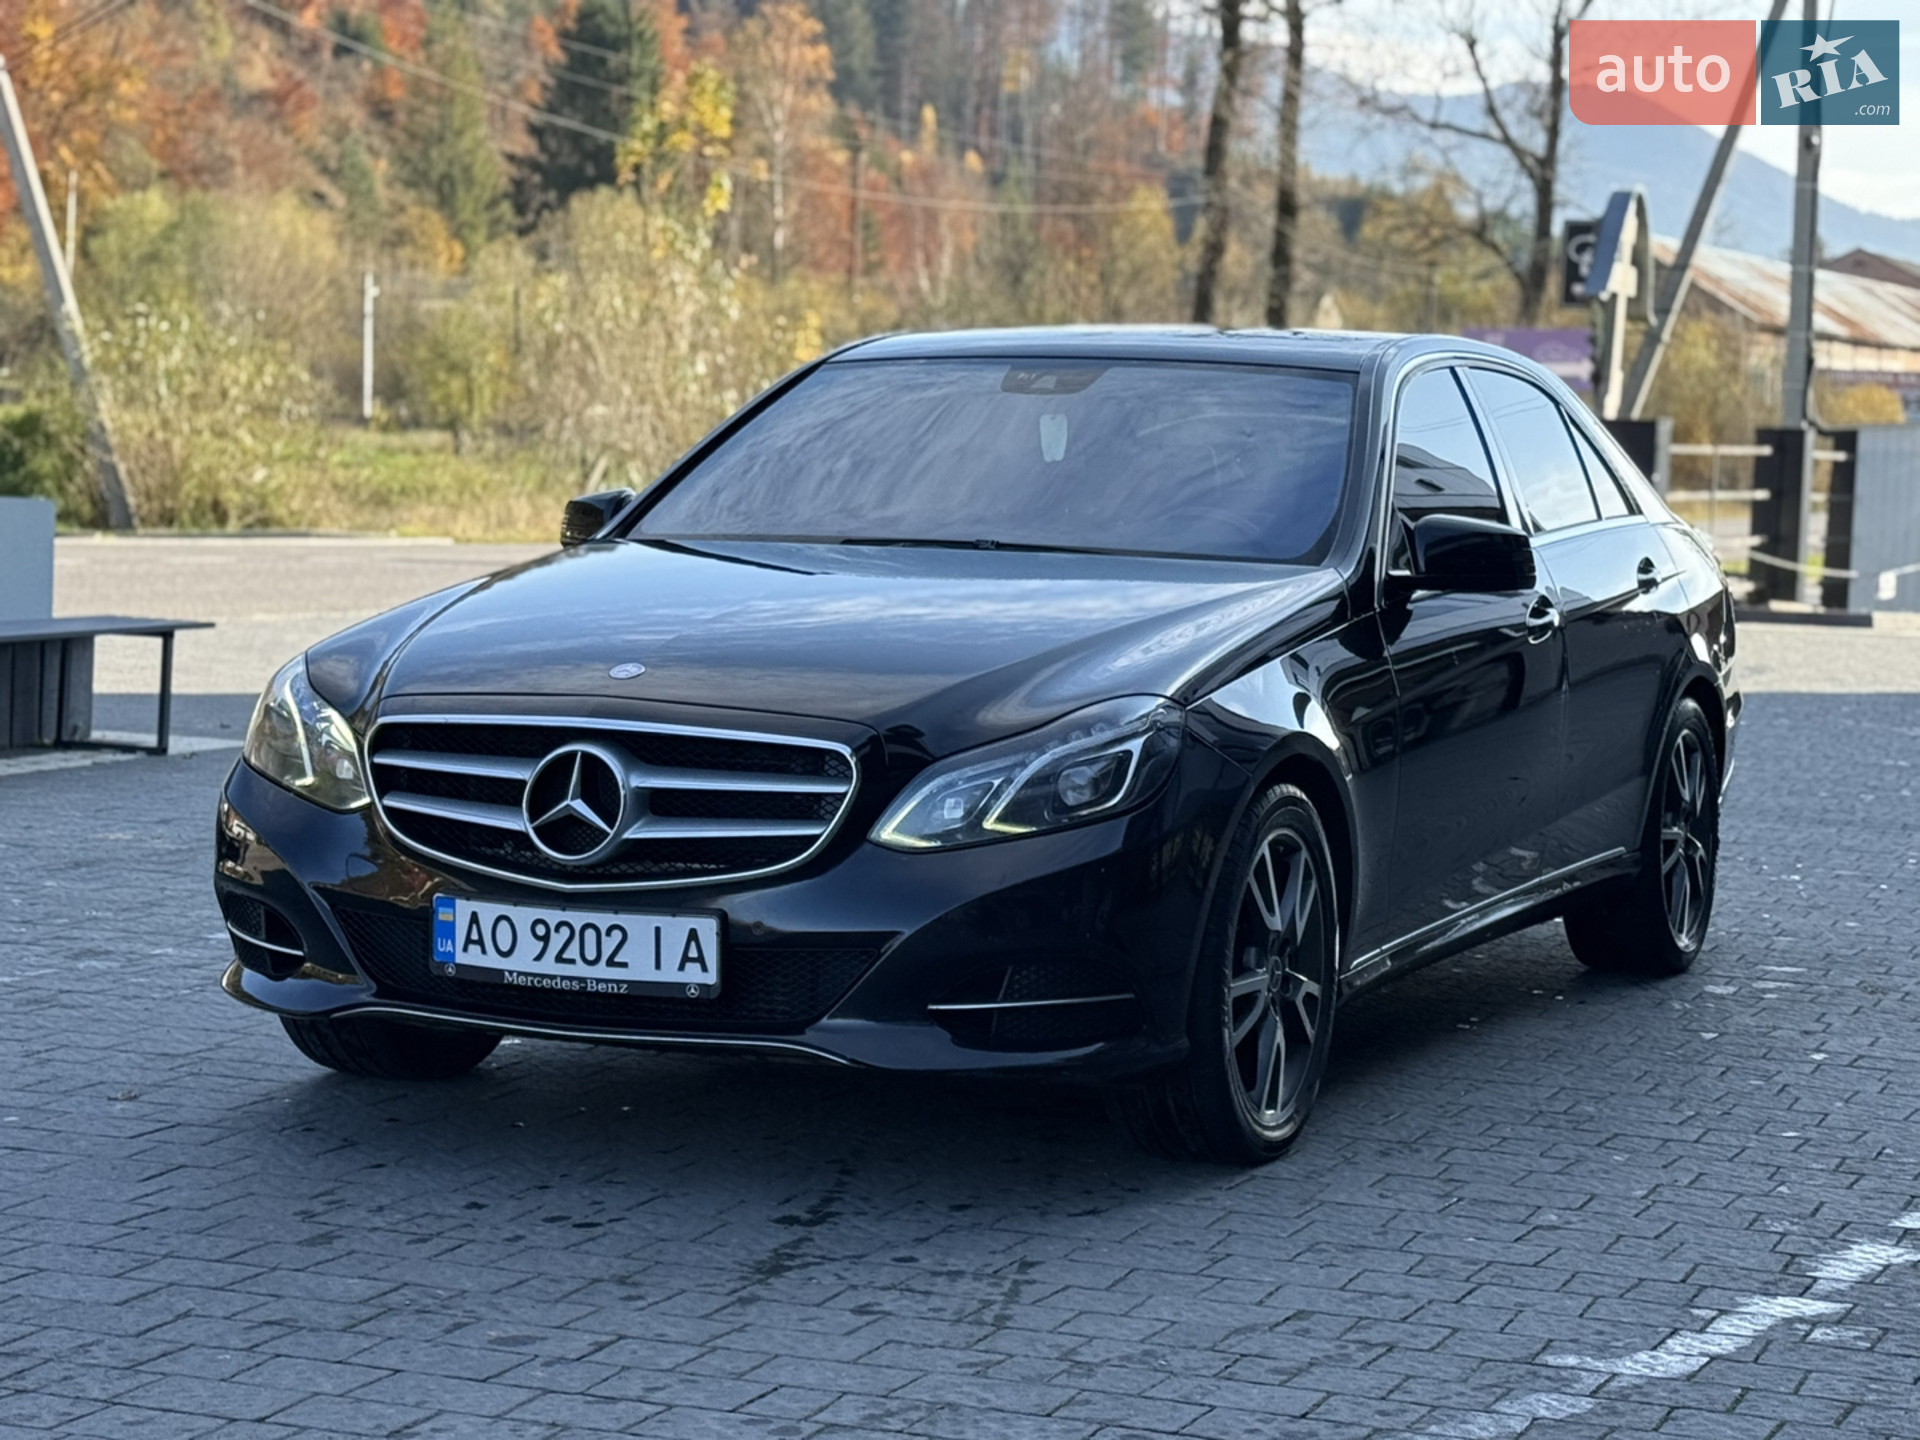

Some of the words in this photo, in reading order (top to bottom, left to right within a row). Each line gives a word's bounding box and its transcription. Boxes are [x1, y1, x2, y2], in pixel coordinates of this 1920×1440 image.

[437, 938, 454, 953] UA
[461, 910, 518, 958] AO
[530, 918, 629, 968] 9202
[503, 971, 629, 994] Mercedes-Benz
